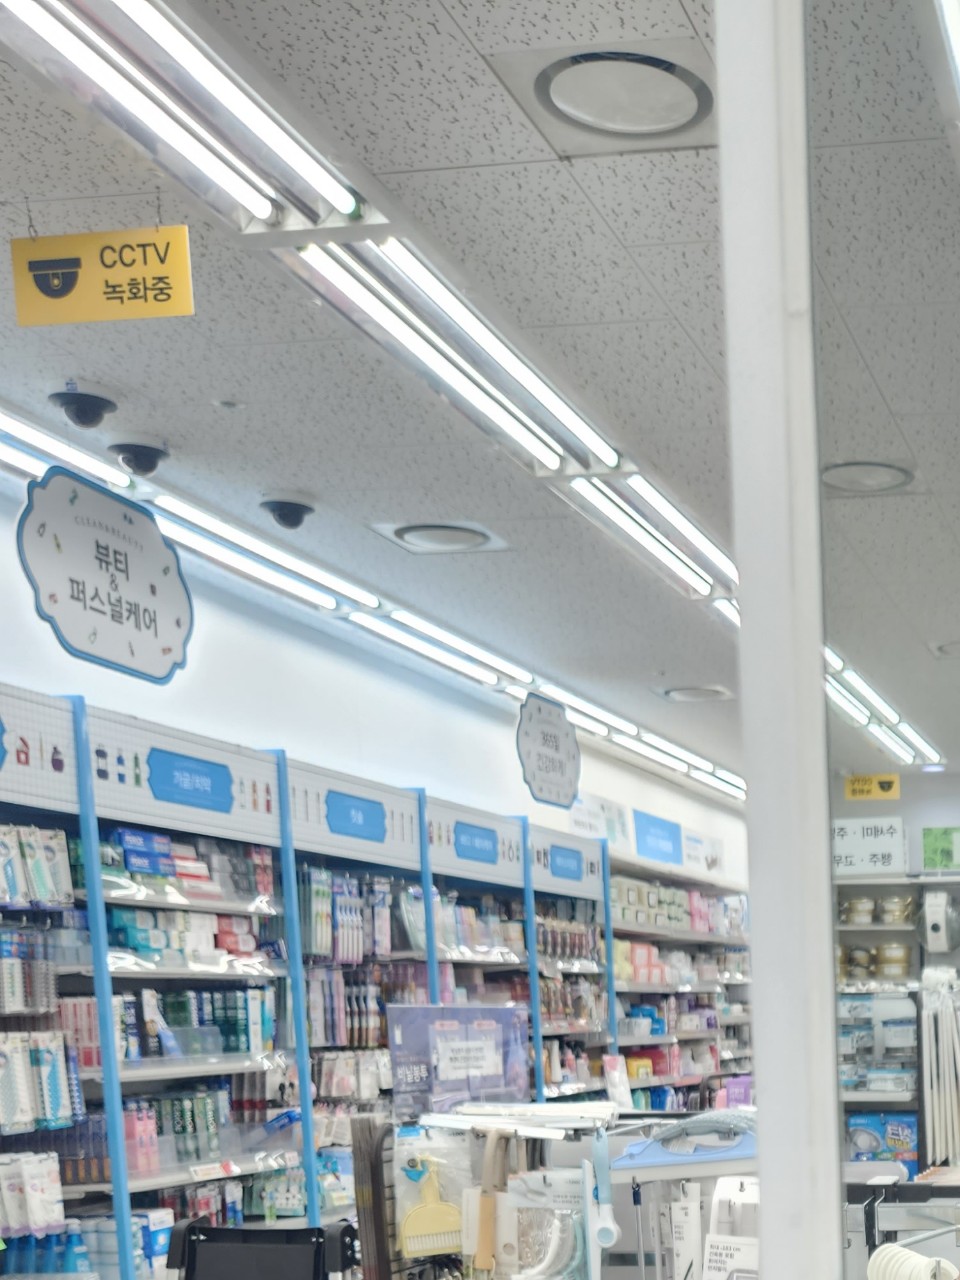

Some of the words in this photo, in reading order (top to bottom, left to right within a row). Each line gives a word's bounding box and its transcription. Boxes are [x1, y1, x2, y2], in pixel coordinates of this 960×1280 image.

[99, 241, 170, 269] CCTV
[103, 276, 173, 305] 녹화중
[94, 539, 130, 582] 뷰티
[109, 573, 119, 592] &
[69, 576, 158, 639] 퍼스널케어
[396, 1063, 429, 1083] 비닐봉투
